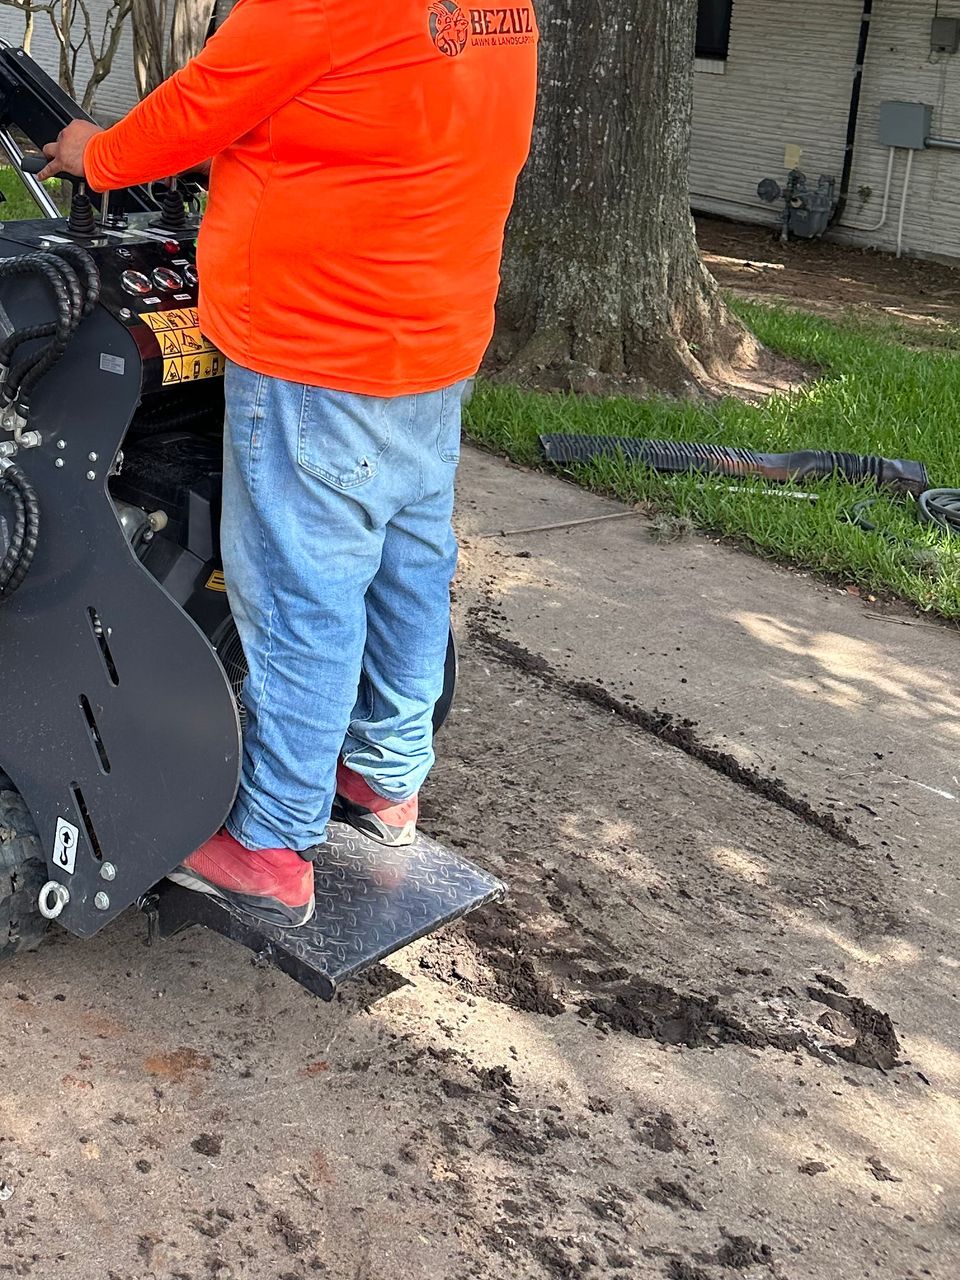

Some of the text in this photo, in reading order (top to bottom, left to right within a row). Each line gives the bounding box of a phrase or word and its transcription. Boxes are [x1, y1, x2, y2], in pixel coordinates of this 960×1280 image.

[469, 8, 532, 35] BEZUZ
[471, 38, 489, 46] LAWN
[491, 38, 496, 46] &
